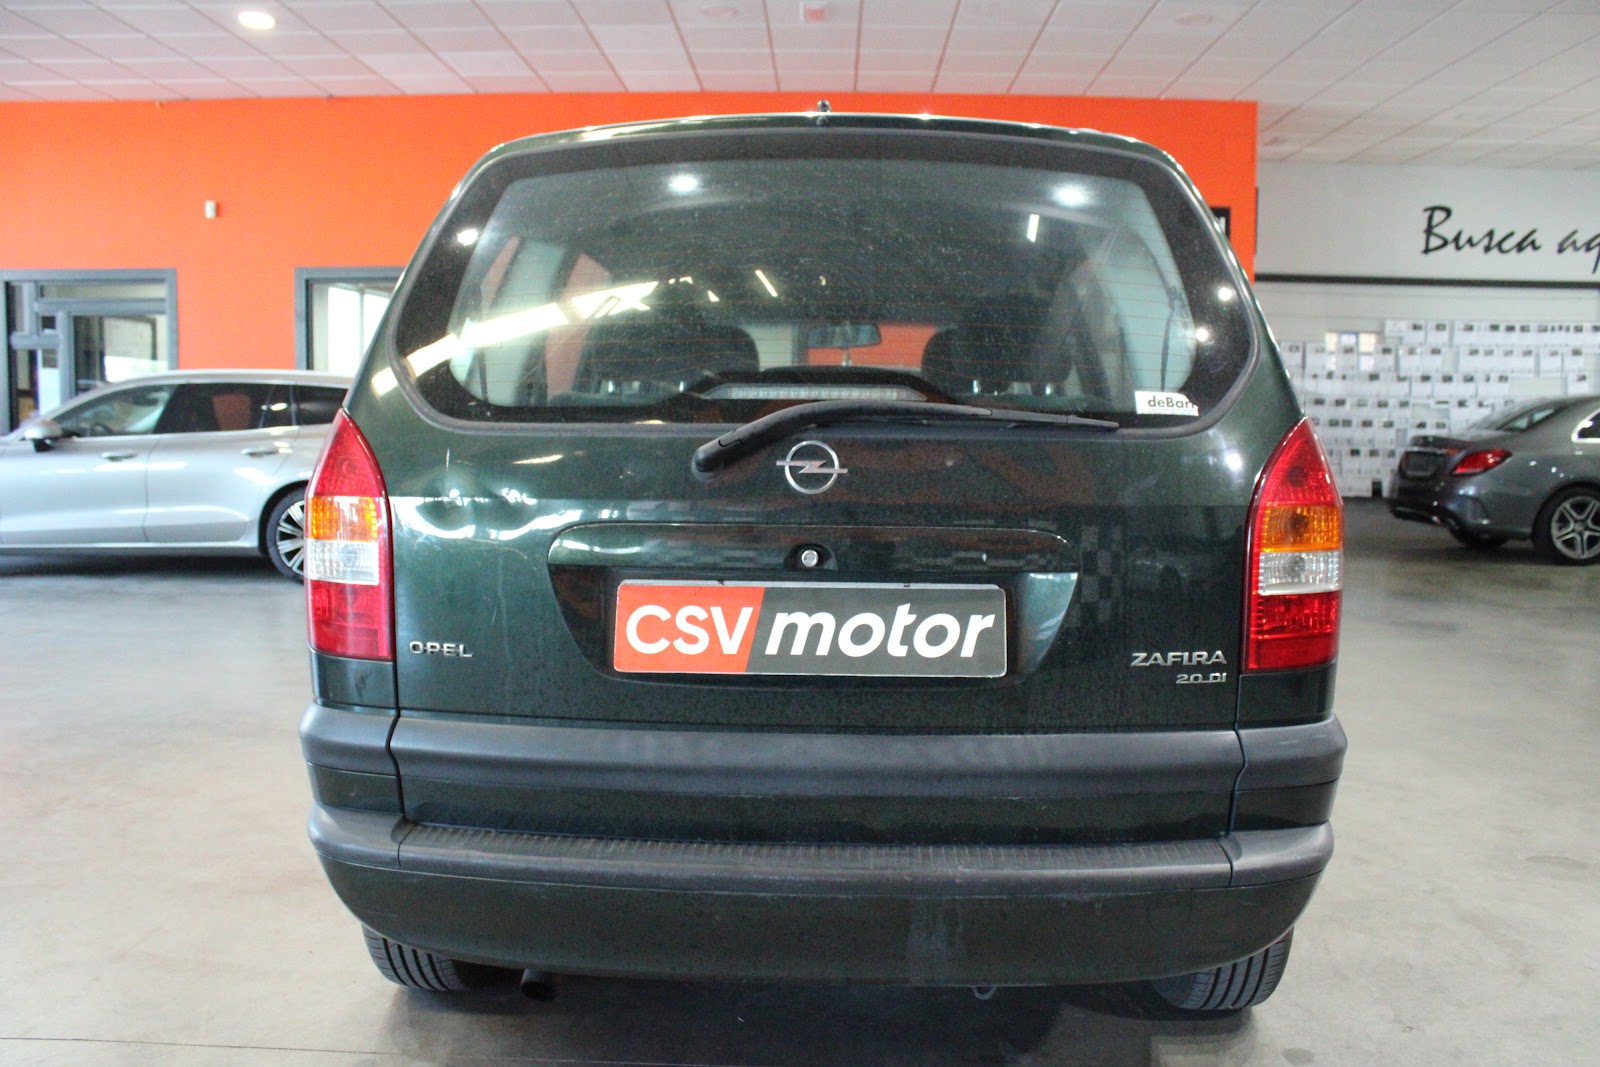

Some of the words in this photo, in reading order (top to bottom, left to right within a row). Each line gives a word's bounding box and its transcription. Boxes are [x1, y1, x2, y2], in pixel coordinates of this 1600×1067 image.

[1422, 205, 1541, 255] Busca
[626, 604, 753, 655] CSV
[764, 603, 995, 658] motor
[409, 640, 473, 658] OPEL
[1131, 650, 1227, 666] ZAFIRA
